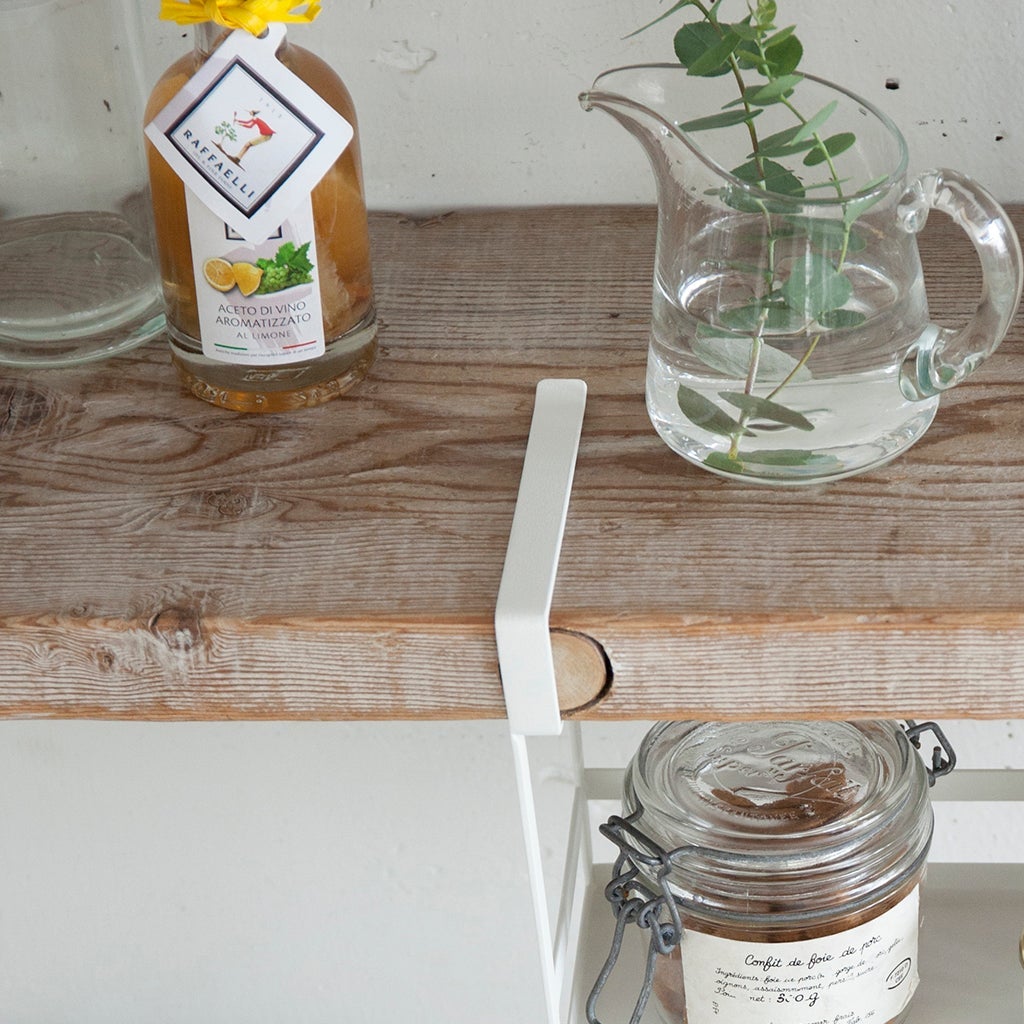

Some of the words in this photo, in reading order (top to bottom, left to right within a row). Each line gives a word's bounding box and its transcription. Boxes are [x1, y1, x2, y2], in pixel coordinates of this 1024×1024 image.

[183, 129, 255, 198] RAFFAELLI
[218, 303, 257, 316] ACETO
[260, 306, 273, 316] DI
[276, 301, 306, 314] VINO
[215, 312, 312, 329] AROMATIZZATO
[236, 331, 247, 339] AL
[252, 330, 293, 340] LIMONE
[744, 954, 782, 972] Confit
[786, 957, 804, 967] de
[806, 953, 835, 970] foie
[839, 946, 857, 958] de
[860, 935, 882, 954] porc
